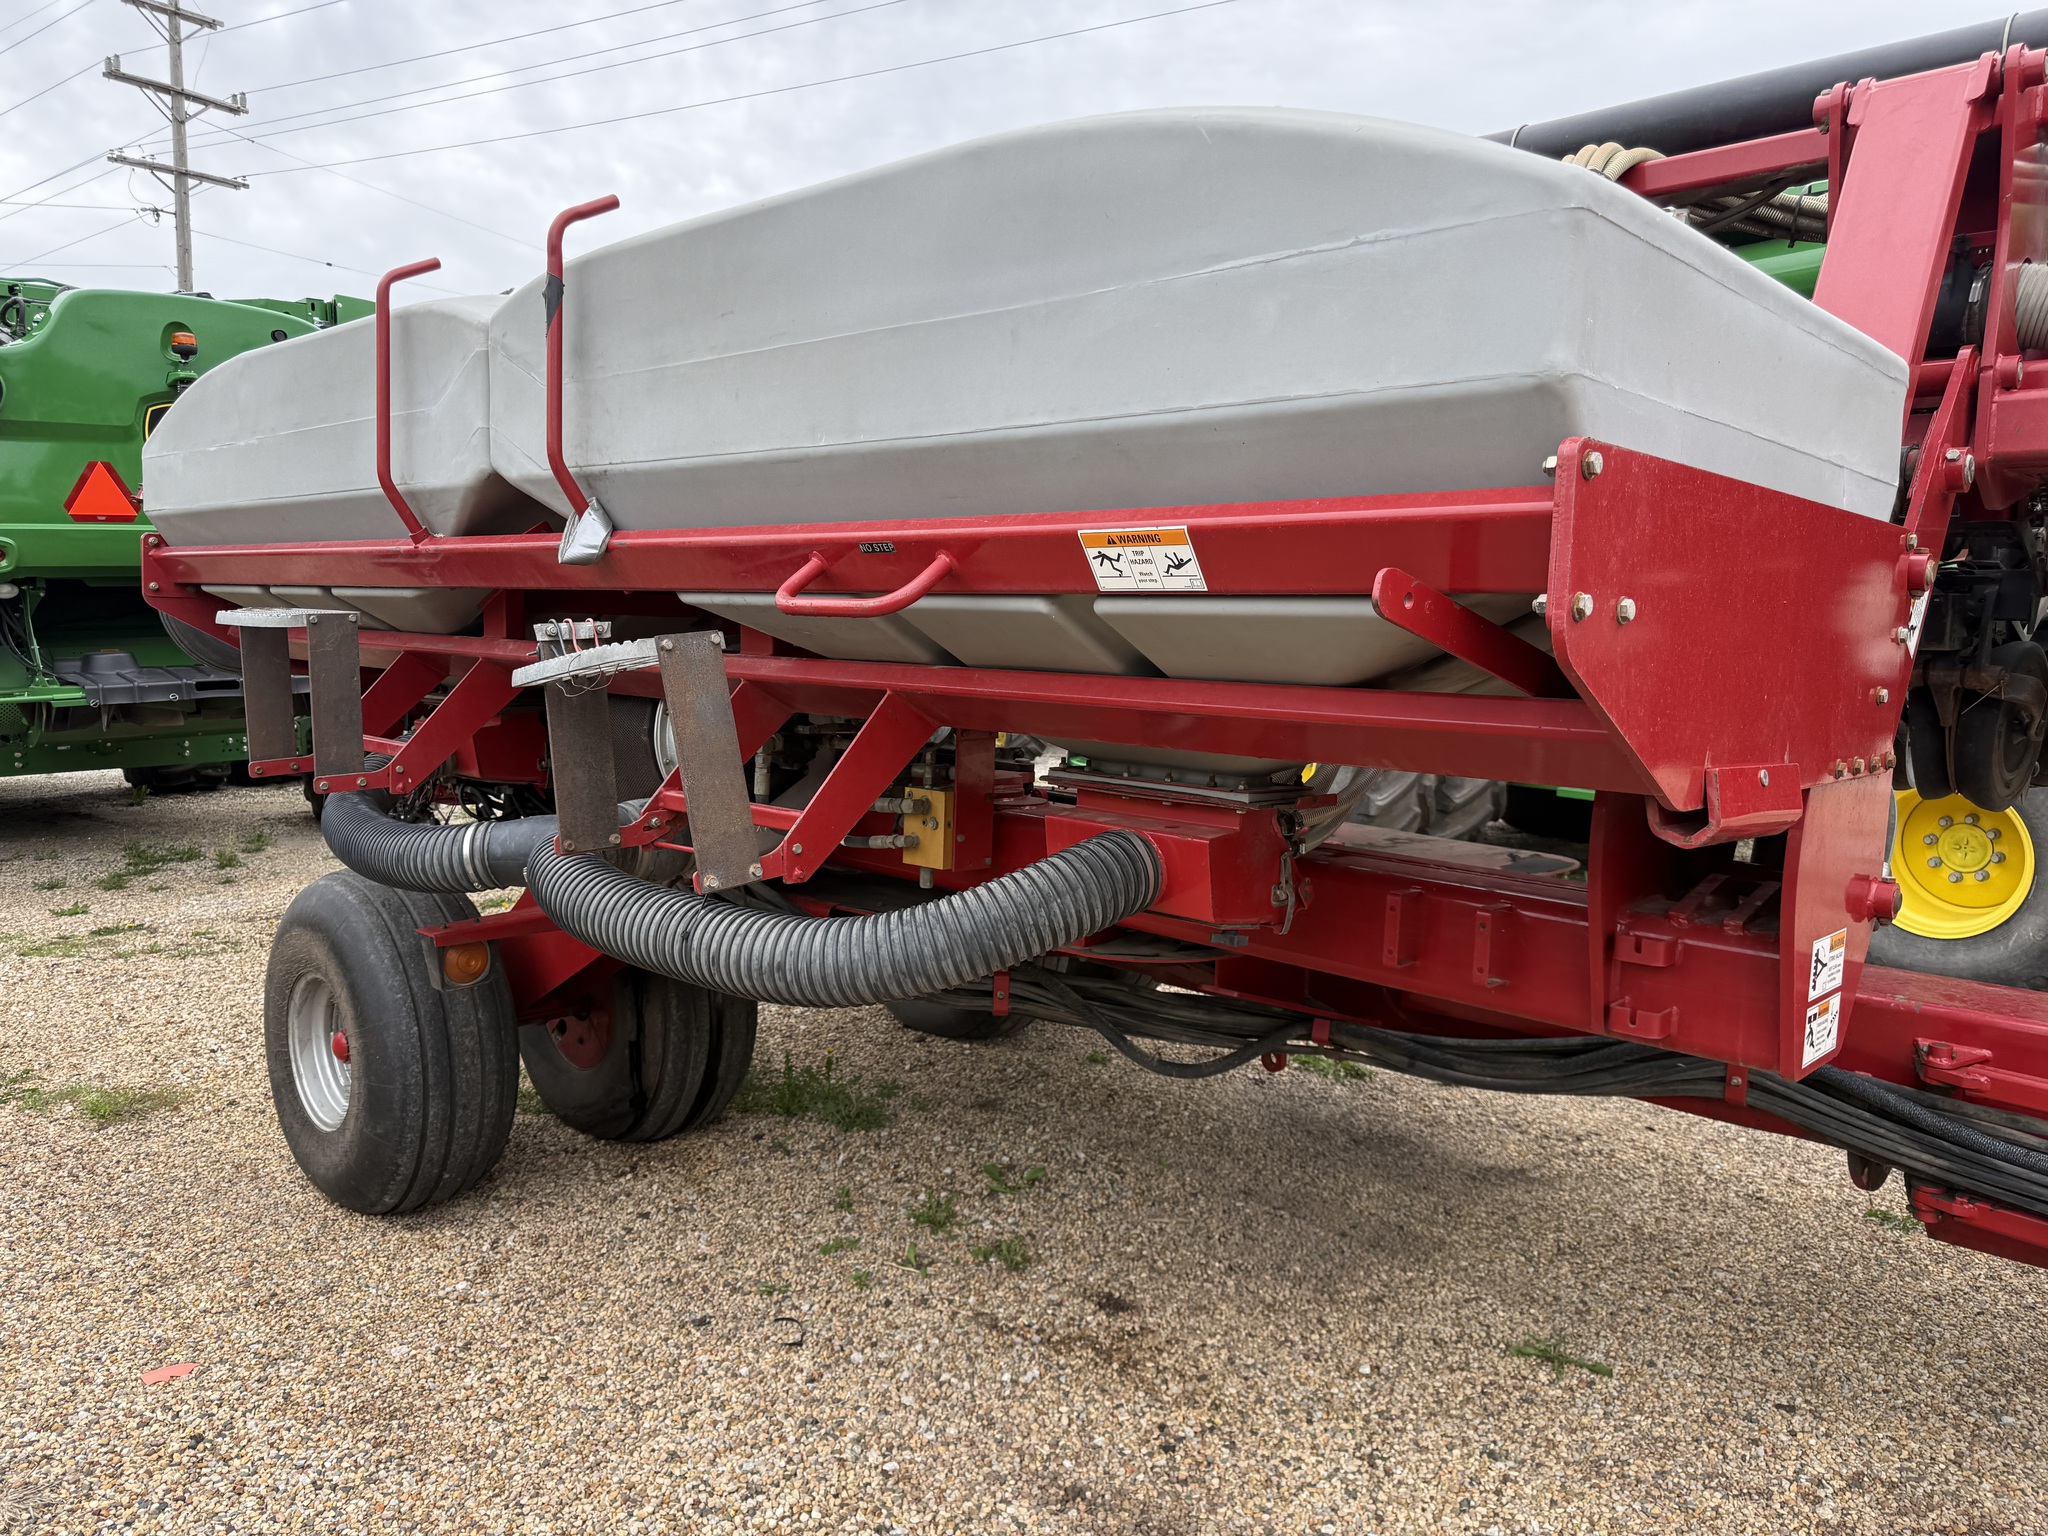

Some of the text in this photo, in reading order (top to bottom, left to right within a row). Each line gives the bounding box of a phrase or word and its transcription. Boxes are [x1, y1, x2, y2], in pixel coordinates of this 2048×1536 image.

[1116, 533, 1161, 544] WARNING
[859, 543, 894, 552] NO STEP
